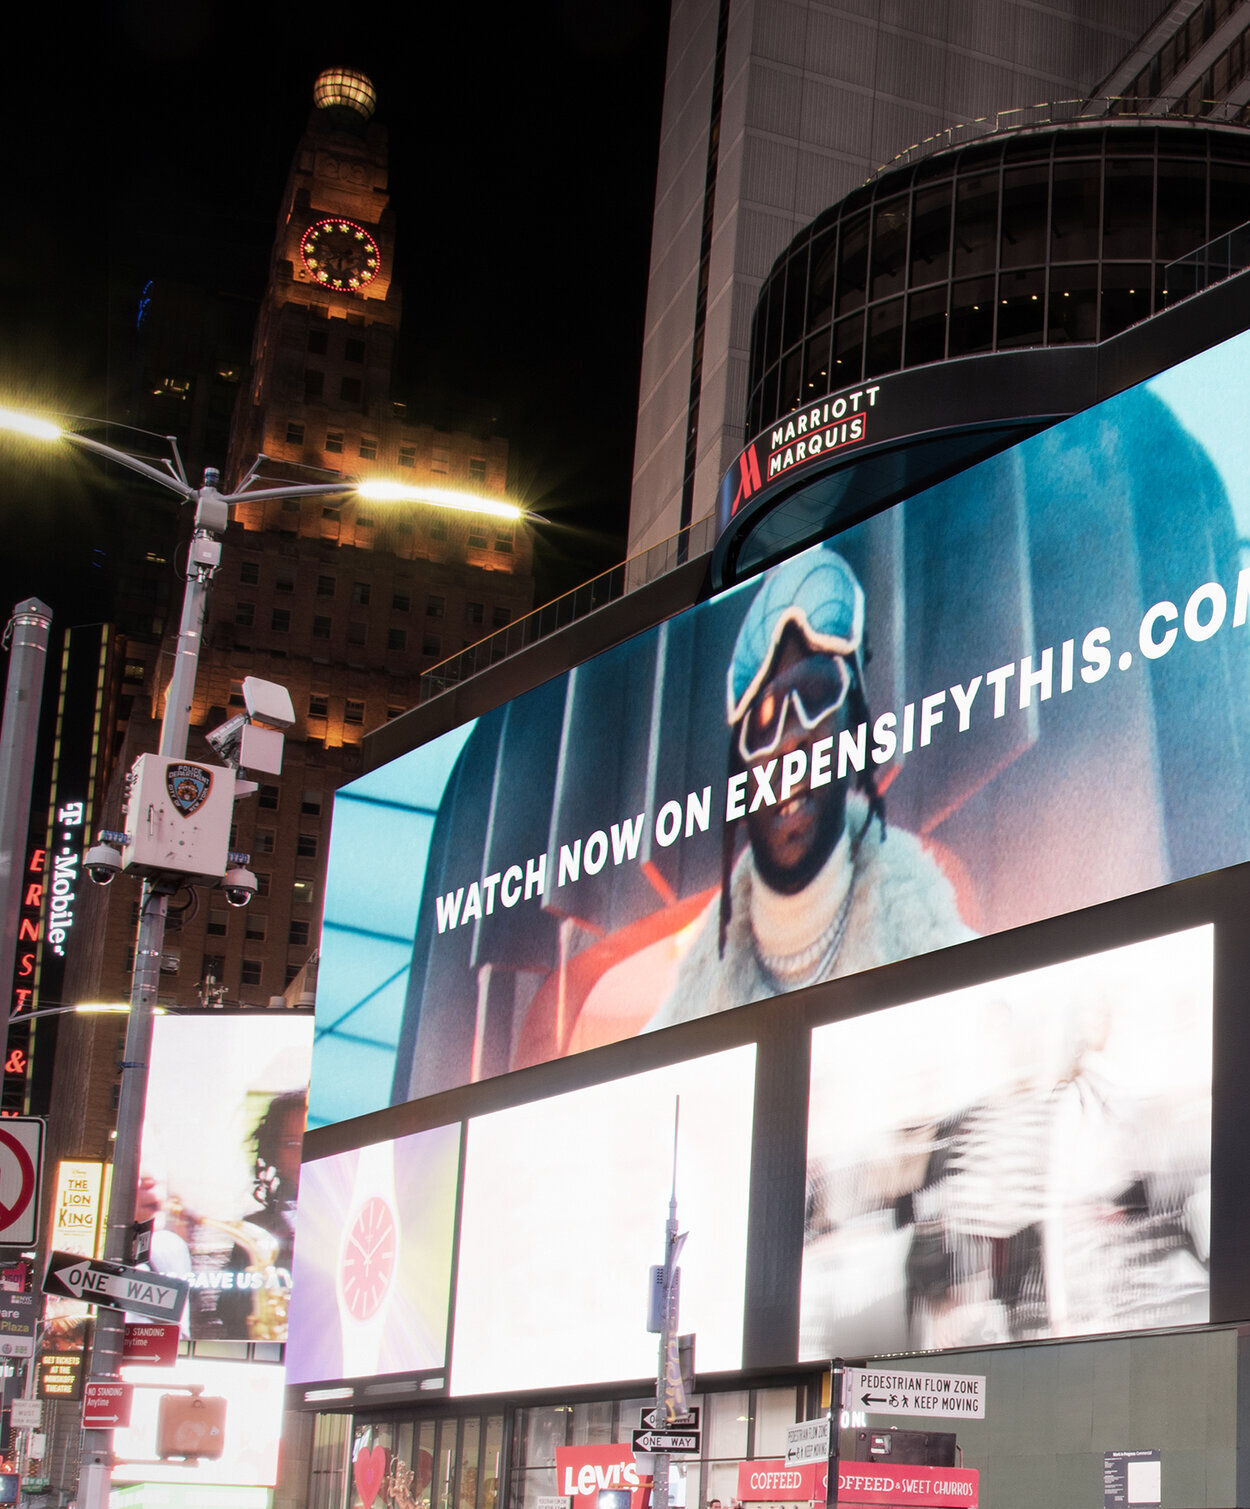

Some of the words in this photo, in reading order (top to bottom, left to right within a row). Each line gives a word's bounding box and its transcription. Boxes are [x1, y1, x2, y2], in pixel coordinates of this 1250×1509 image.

[771, 386, 880, 450] MARRIOTT
[770, 418, 863, 476] MARQUIS
[168, 770, 210, 785] DEPARTMENT
[178, 765, 203, 777] POLICE
[435, 851, 546, 934] WATCH
[558, 812, 645, 898] NOW
[654, 787, 711, 848] ON
[68, 1179, 88, 1189] THE
[63, 1191, 91, 1207] LION
[58, 1208, 93, 1227] KING
[69, 1269, 109, 1292] ONE
[127, 1281, 170, 1304] WAY
[236, 1271, 263, 1289] US
[1, 1320, 30, 1332] Plaza
[132, 1328, 165, 1337] STANDING
[124, 1338, 148, 1347] nytime
[88, 1387, 96, 1396] NO
[97, 1387, 123, 1397] STANDING
[860, 1374, 922, 1391] PEDESTRIAN
[924, 1379, 951, 1392] FLOW
[954, 1380, 979, 1394] ZONE
[87, 1398, 110, 1407] Anytime
[914, 1396, 938, 1409] KEEP
[942, 1397, 979, 1412] MOVING
[642, 1437, 662, 1446] ONE
[671, 1437, 692, 1447] WAY
[750, 1472, 802, 1490] COFFEED
[895, 1481, 901, 1490] &
[901, 1479, 931, 1495] SWEET
[933, 1481, 973, 1496] CHURROS
